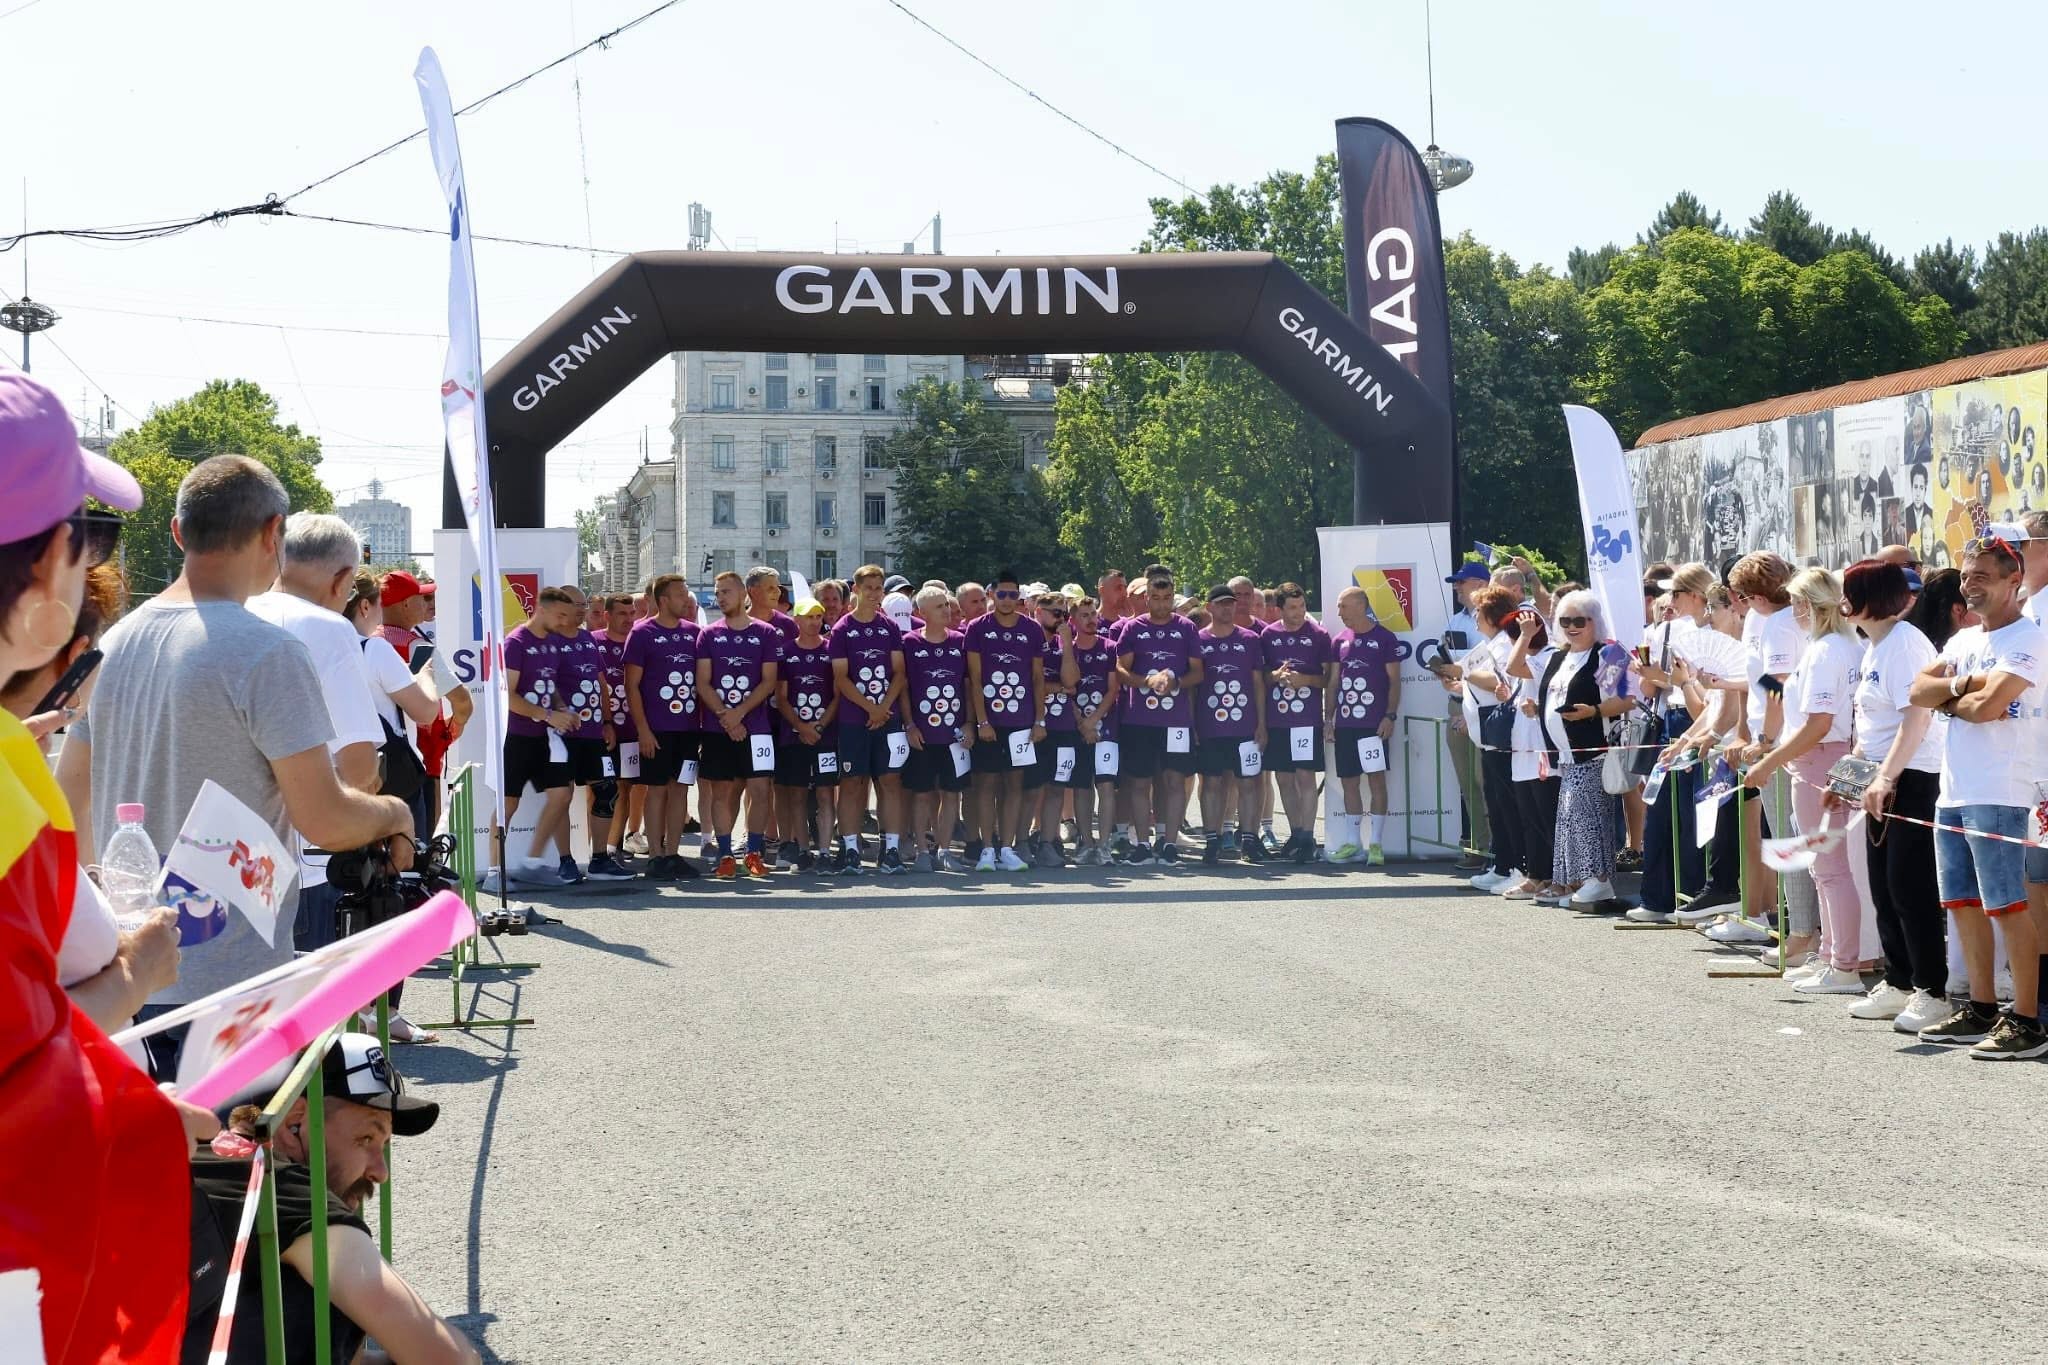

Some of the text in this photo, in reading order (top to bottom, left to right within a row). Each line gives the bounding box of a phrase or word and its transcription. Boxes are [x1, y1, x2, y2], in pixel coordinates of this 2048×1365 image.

[775, 265, 1119, 315] GARMIN
[512, 306, 632, 411] GARMIN
[1278, 307, 1394, 412] GARMIN
[1175, 730, 1183, 740] 3
[1016, 743, 1029, 754] 37
[1297, 738, 1309, 748] 12
[756, 747, 770, 758] 30
[897, 745, 906, 756] 16
[1365, 749, 1380, 760] 33
[628, 755, 638, 766] 18
[821, 757, 836, 768] 22
[1103, 753, 1111, 762] 9
[1061, 760, 1073, 769] 40
